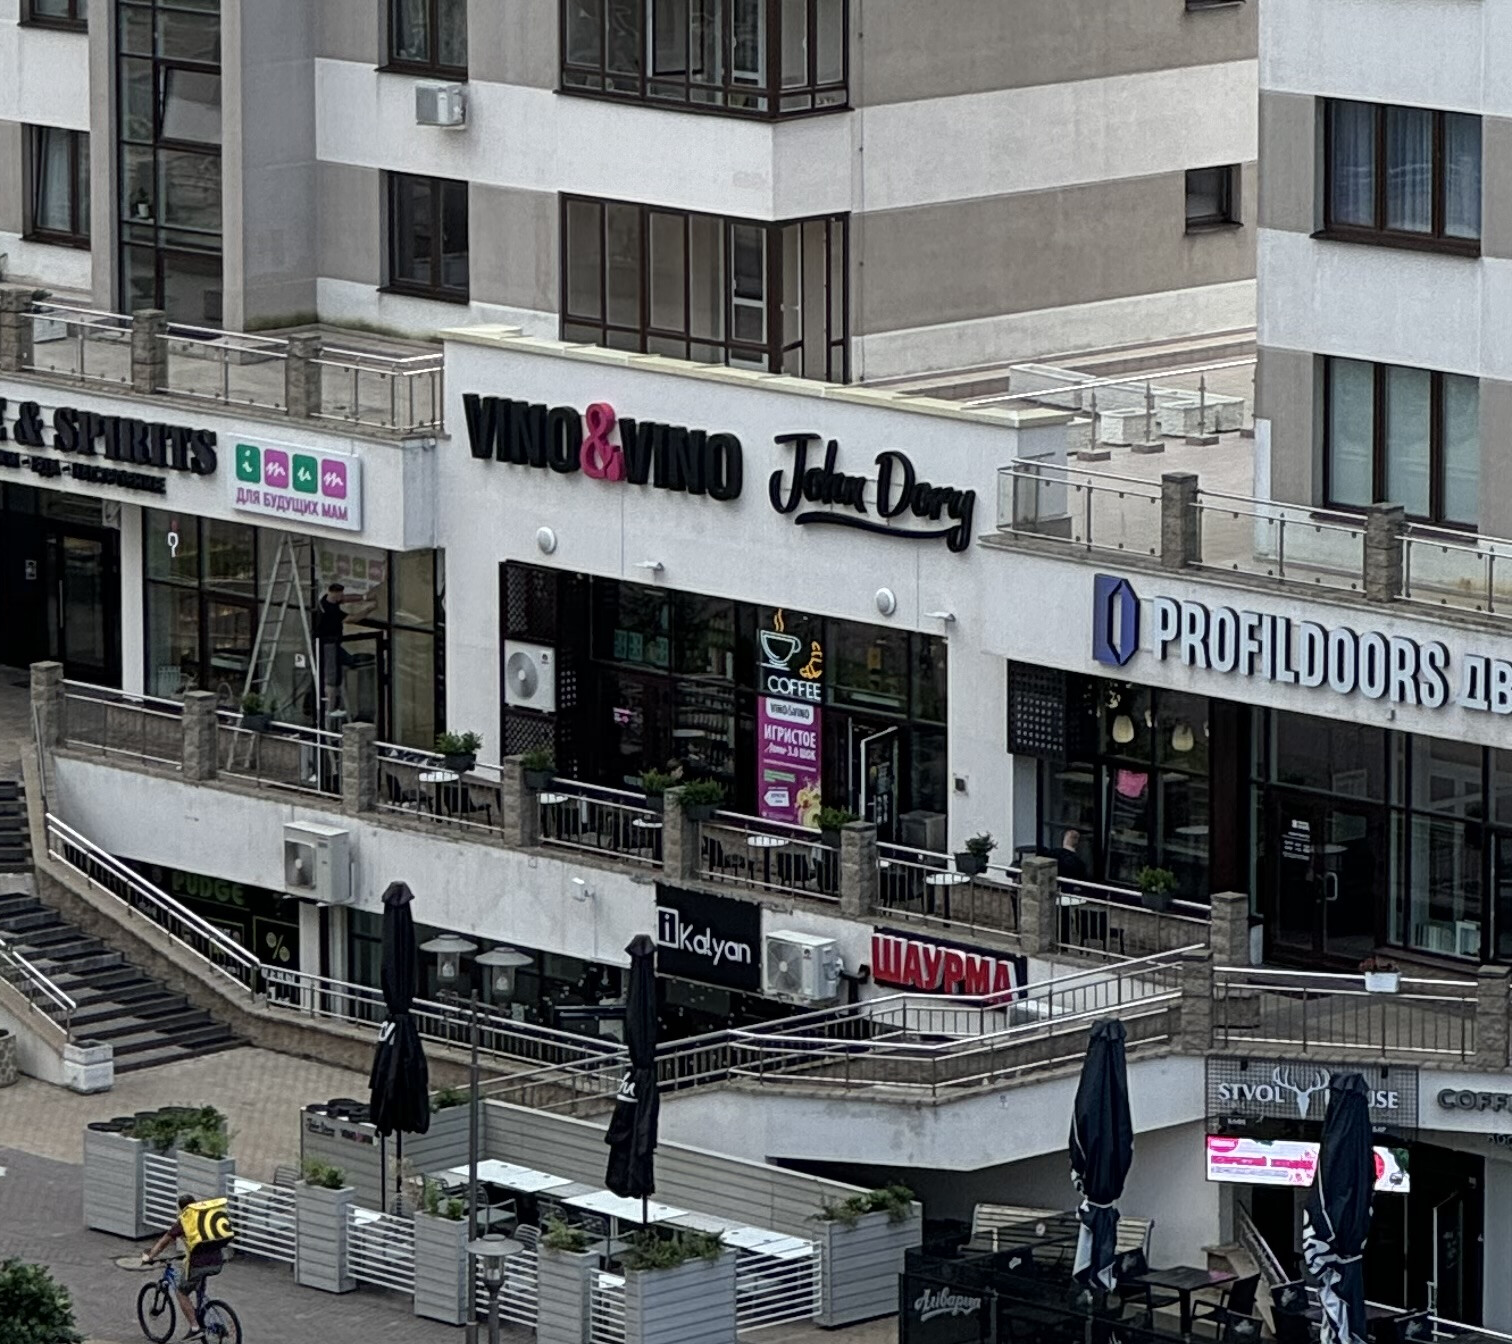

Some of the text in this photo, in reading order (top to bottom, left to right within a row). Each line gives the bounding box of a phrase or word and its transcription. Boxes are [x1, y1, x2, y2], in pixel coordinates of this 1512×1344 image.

[13, 401, 44, 447] &
[53, 406, 217, 475] SPIRITS
[463, 393, 743, 501] VINO&VINO
[236, 487, 348, 521] ДЛЯ БУДУЩИХ МАМ
[769, 433, 976, 553] John Dory
[1152, 596, 1451, 709] PROFILDOORS
[768, 675, 821, 700] COFFEE
[764, 723, 816, 748] ИГРИСТОЕ
[172, 871, 246, 905] PUDGE
[871, 933, 1017, 1003] ШАУРМА
[1218, 1083, 1286, 1103] STVOL
